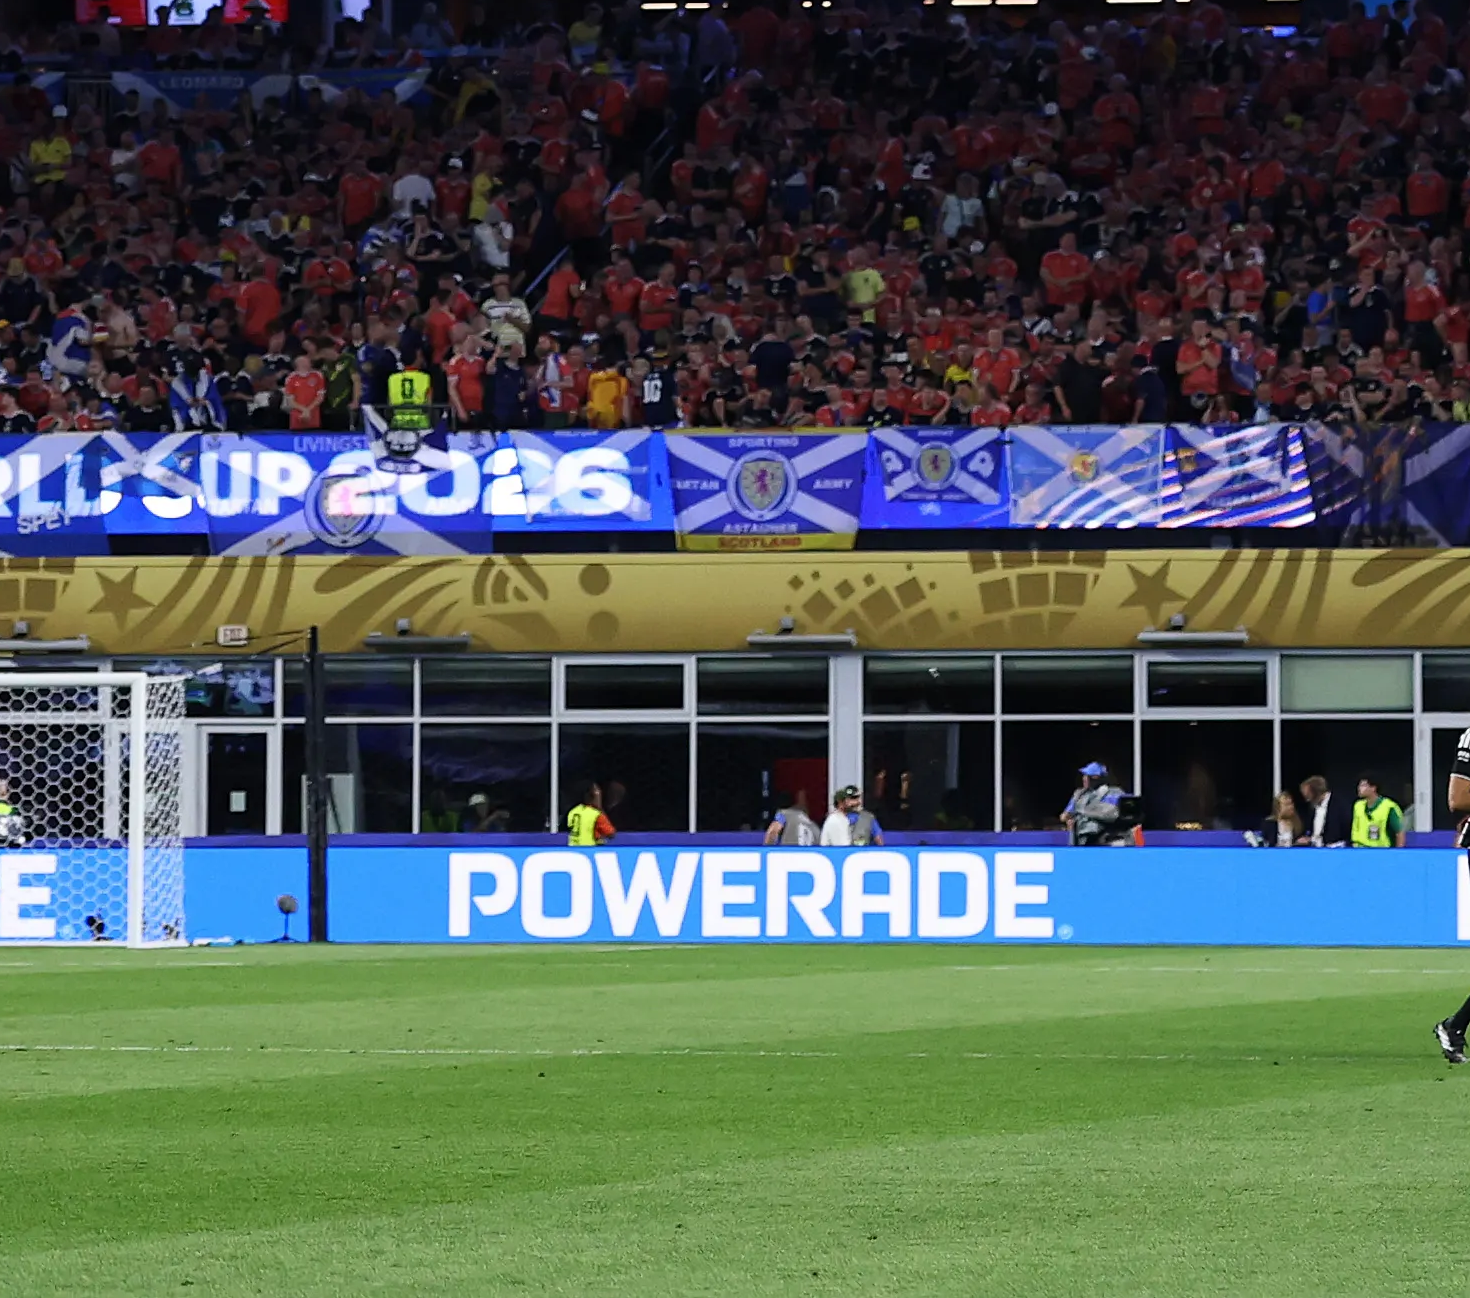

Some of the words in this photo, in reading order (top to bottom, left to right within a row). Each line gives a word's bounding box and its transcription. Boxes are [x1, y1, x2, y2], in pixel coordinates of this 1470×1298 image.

[293, 434, 370, 453] LIVINGST
[16, 501, 74, 535] SPEY
[718, 536, 803, 549] SCOTLAND
[448, 850, 1056, 939] POWERADE
